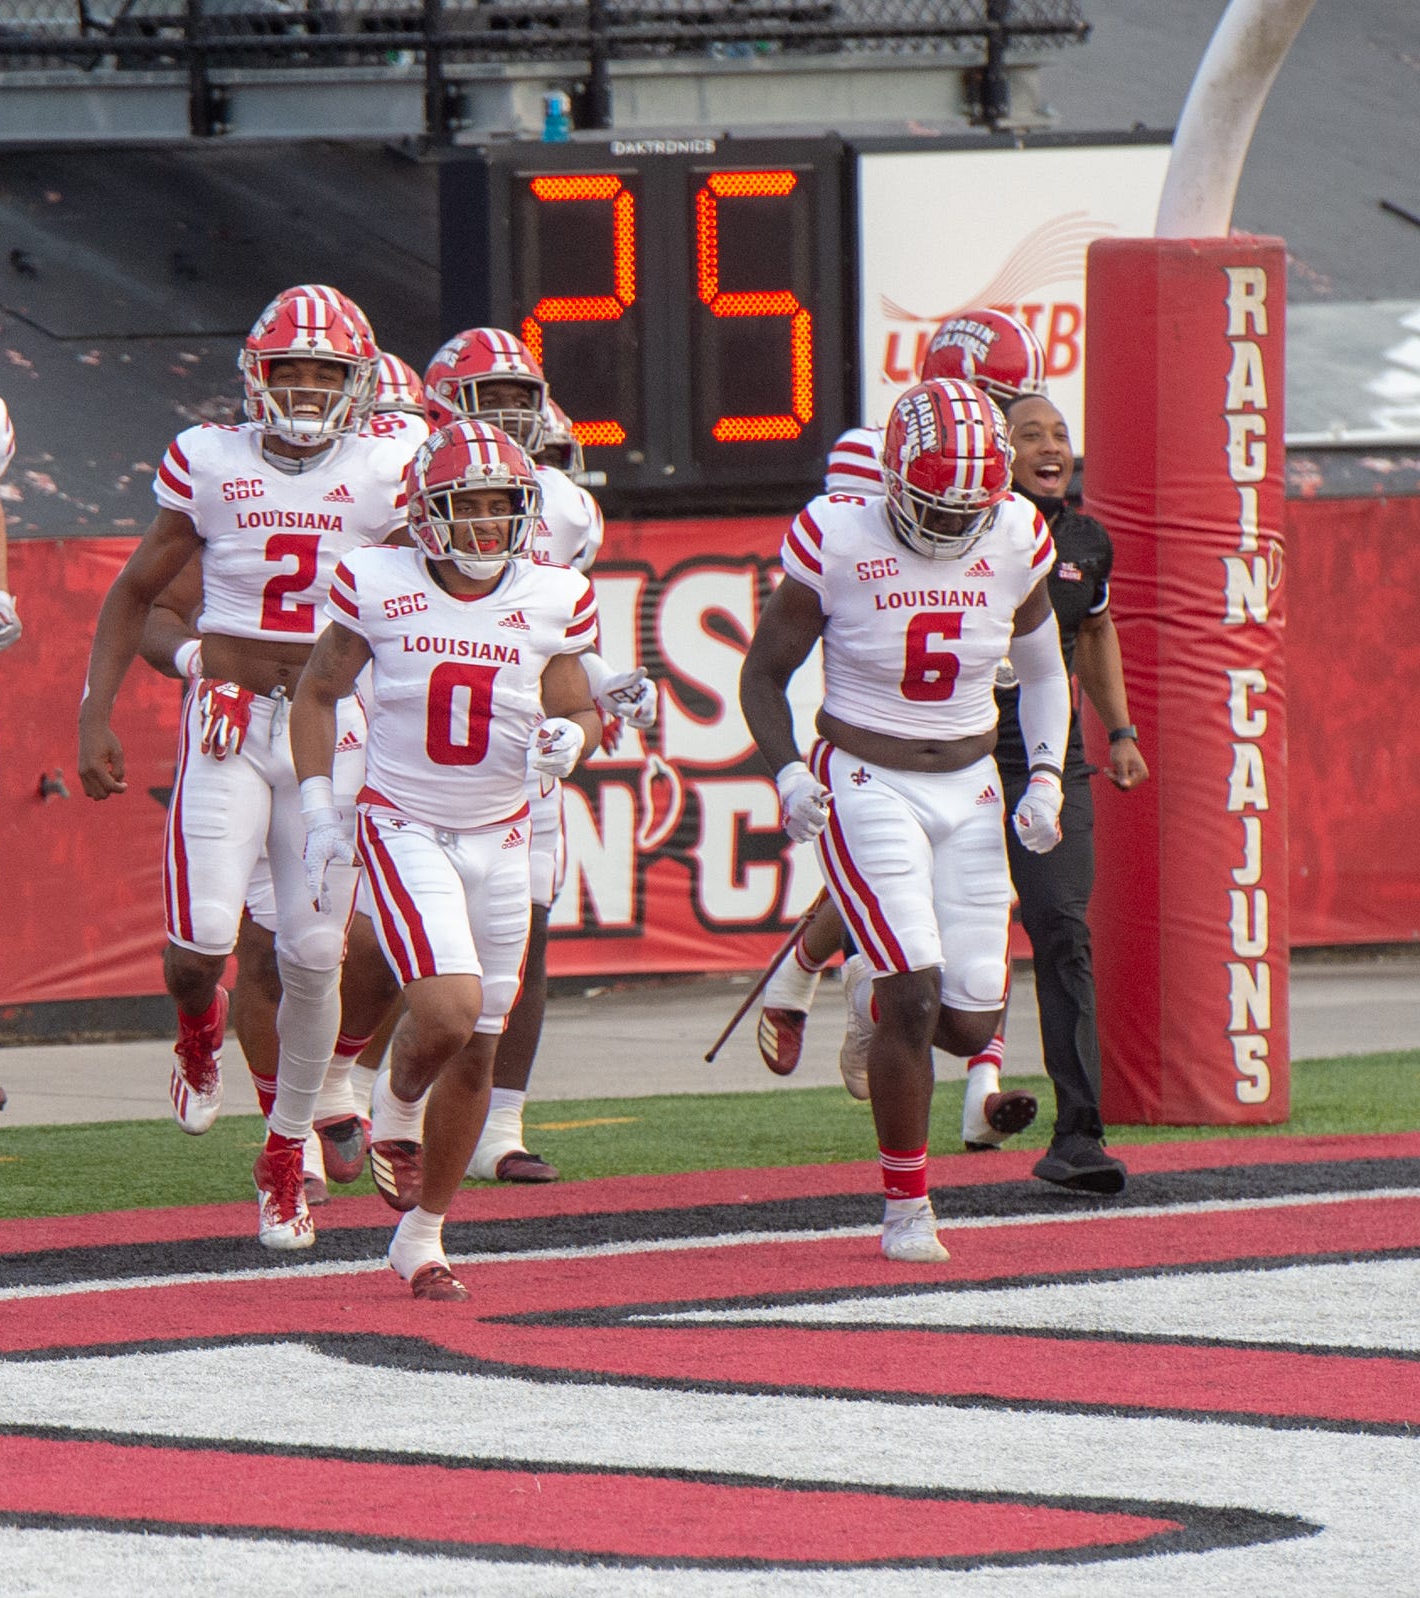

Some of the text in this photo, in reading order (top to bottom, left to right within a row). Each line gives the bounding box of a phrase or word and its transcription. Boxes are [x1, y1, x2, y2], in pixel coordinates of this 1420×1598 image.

[611, 139, 717, 156] DAKTRONICS
[522, 169, 814, 446] 25
[221, 478, 265, 502] SBC
[236, 509, 344, 533] LOUISIANA
[260, 532, 322, 634] 2
[855, 557, 900, 582] SBC
[383, 591, 429, 620] SBC
[875, 590, 989, 611] LOUISIANA
[402, 635, 521, 665] LOUISIANA
[900, 611, 966, 702] 6
[425, 660, 502, 767] 0
[1224, 667, 1271, 1105] CAJUNS
